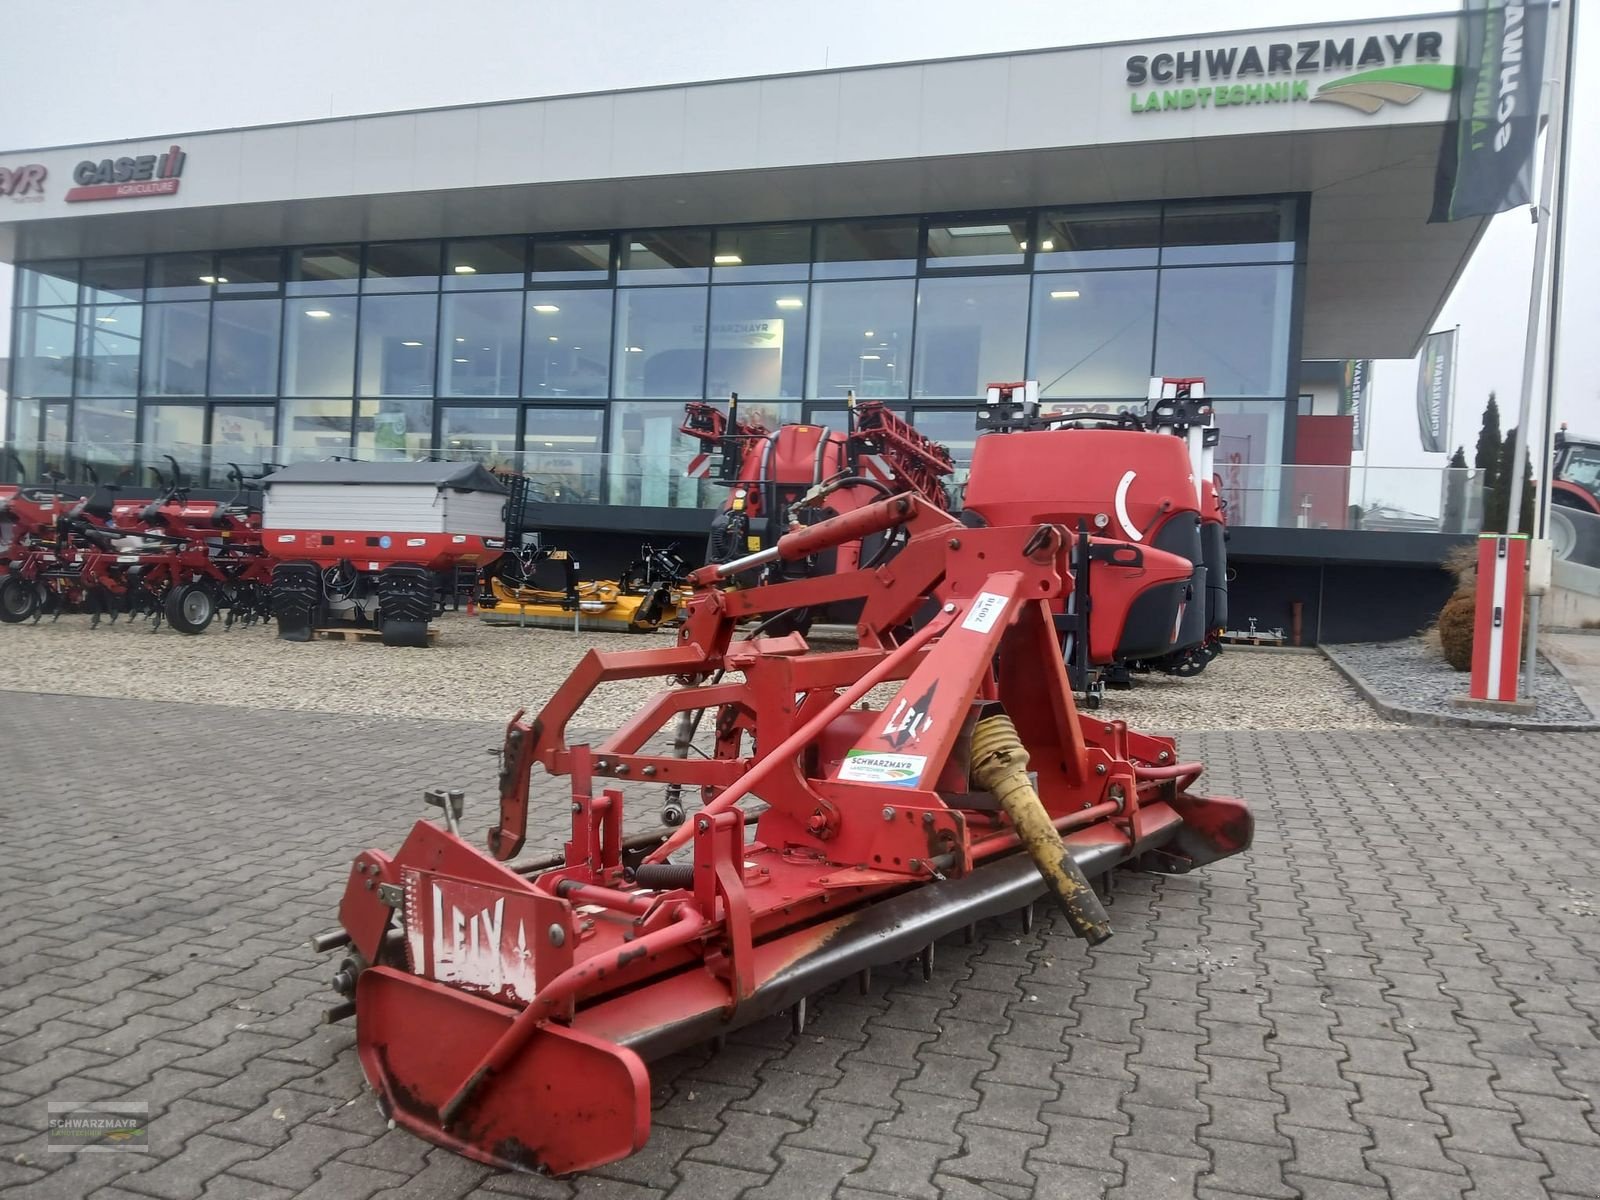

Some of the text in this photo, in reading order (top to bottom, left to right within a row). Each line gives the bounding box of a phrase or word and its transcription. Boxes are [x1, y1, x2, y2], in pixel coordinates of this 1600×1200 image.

[1126, 31, 1443, 86] SCHWARZMAYR
[1130, 80, 1309, 114] LANDTECHNIK
[73, 155, 157, 186] CASE
[117, 181, 174, 195] AGRICULTURE
[851, 757, 913, 769] SCHWARZMAYR
